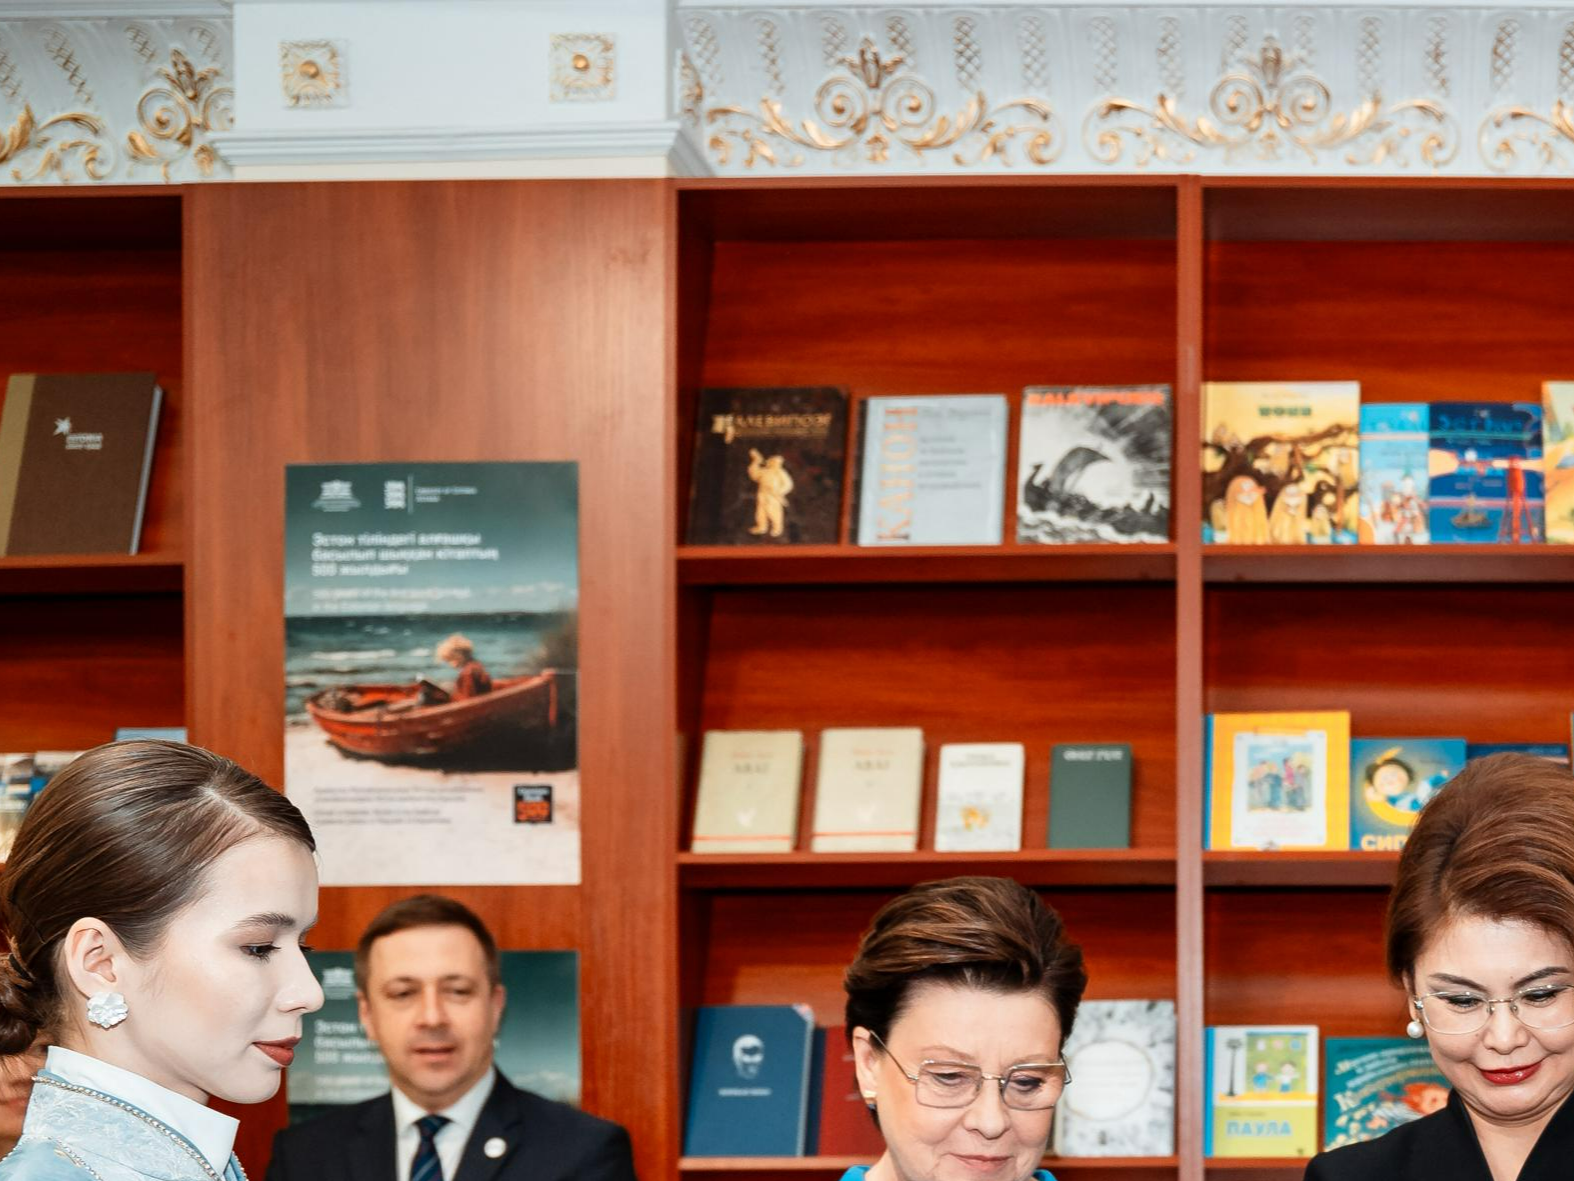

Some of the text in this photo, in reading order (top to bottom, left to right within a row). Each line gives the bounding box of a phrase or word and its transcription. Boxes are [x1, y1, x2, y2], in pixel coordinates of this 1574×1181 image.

[877, 407, 918, 541] КАНОН
[312, 532, 356, 547] Эстон
[1226, 1119, 1292, 1138] ПАУЛА
